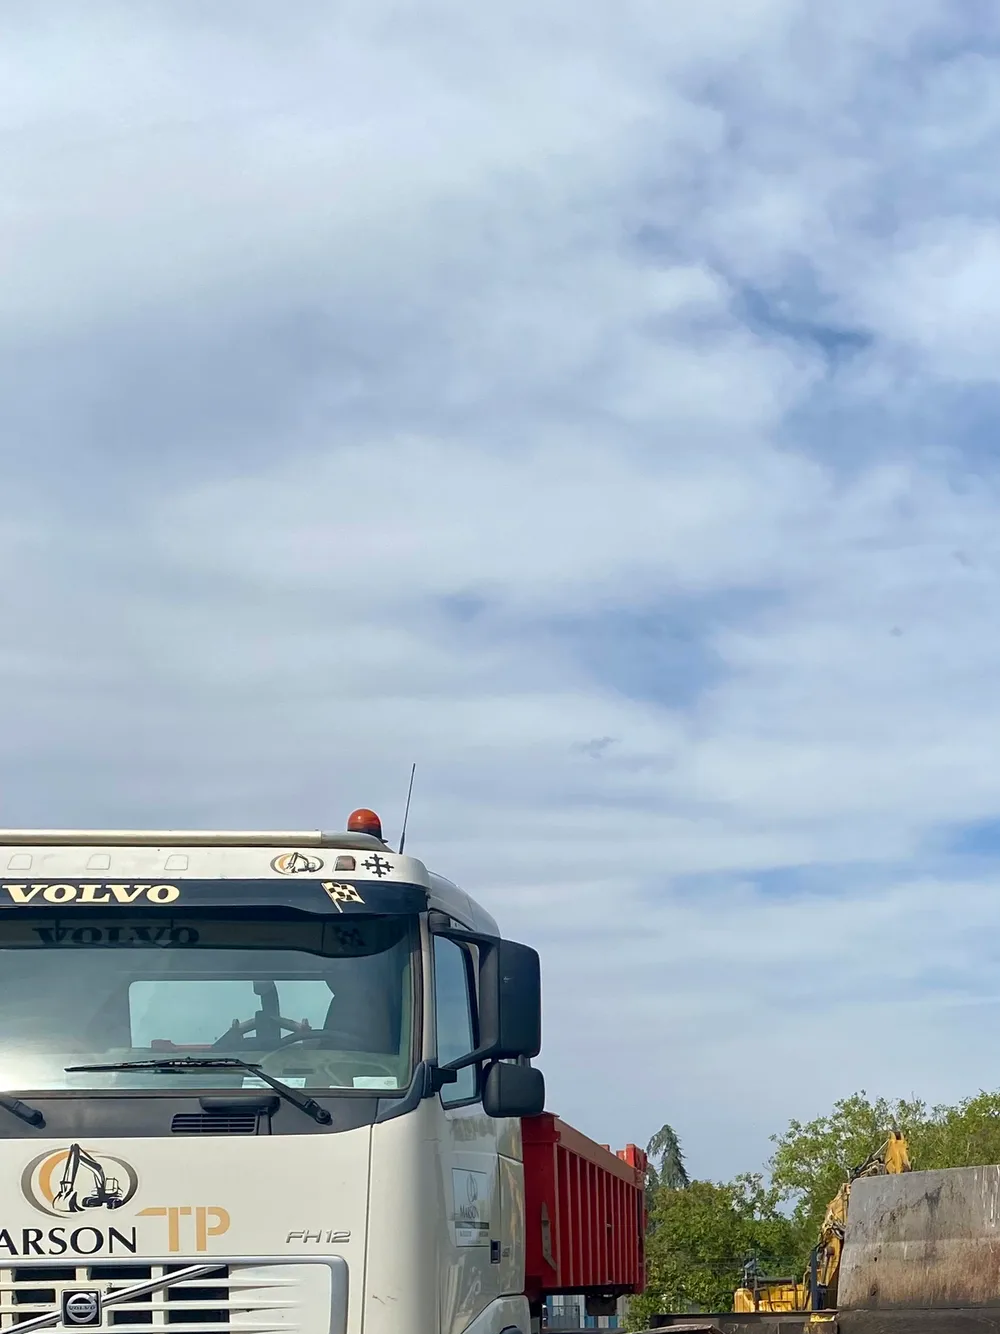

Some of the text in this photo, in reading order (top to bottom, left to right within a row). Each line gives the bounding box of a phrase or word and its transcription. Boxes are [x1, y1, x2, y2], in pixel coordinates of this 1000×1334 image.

[2, 884, 180, 903] VOLVO
[0, 1206, 231, 1256] ARSON TP
